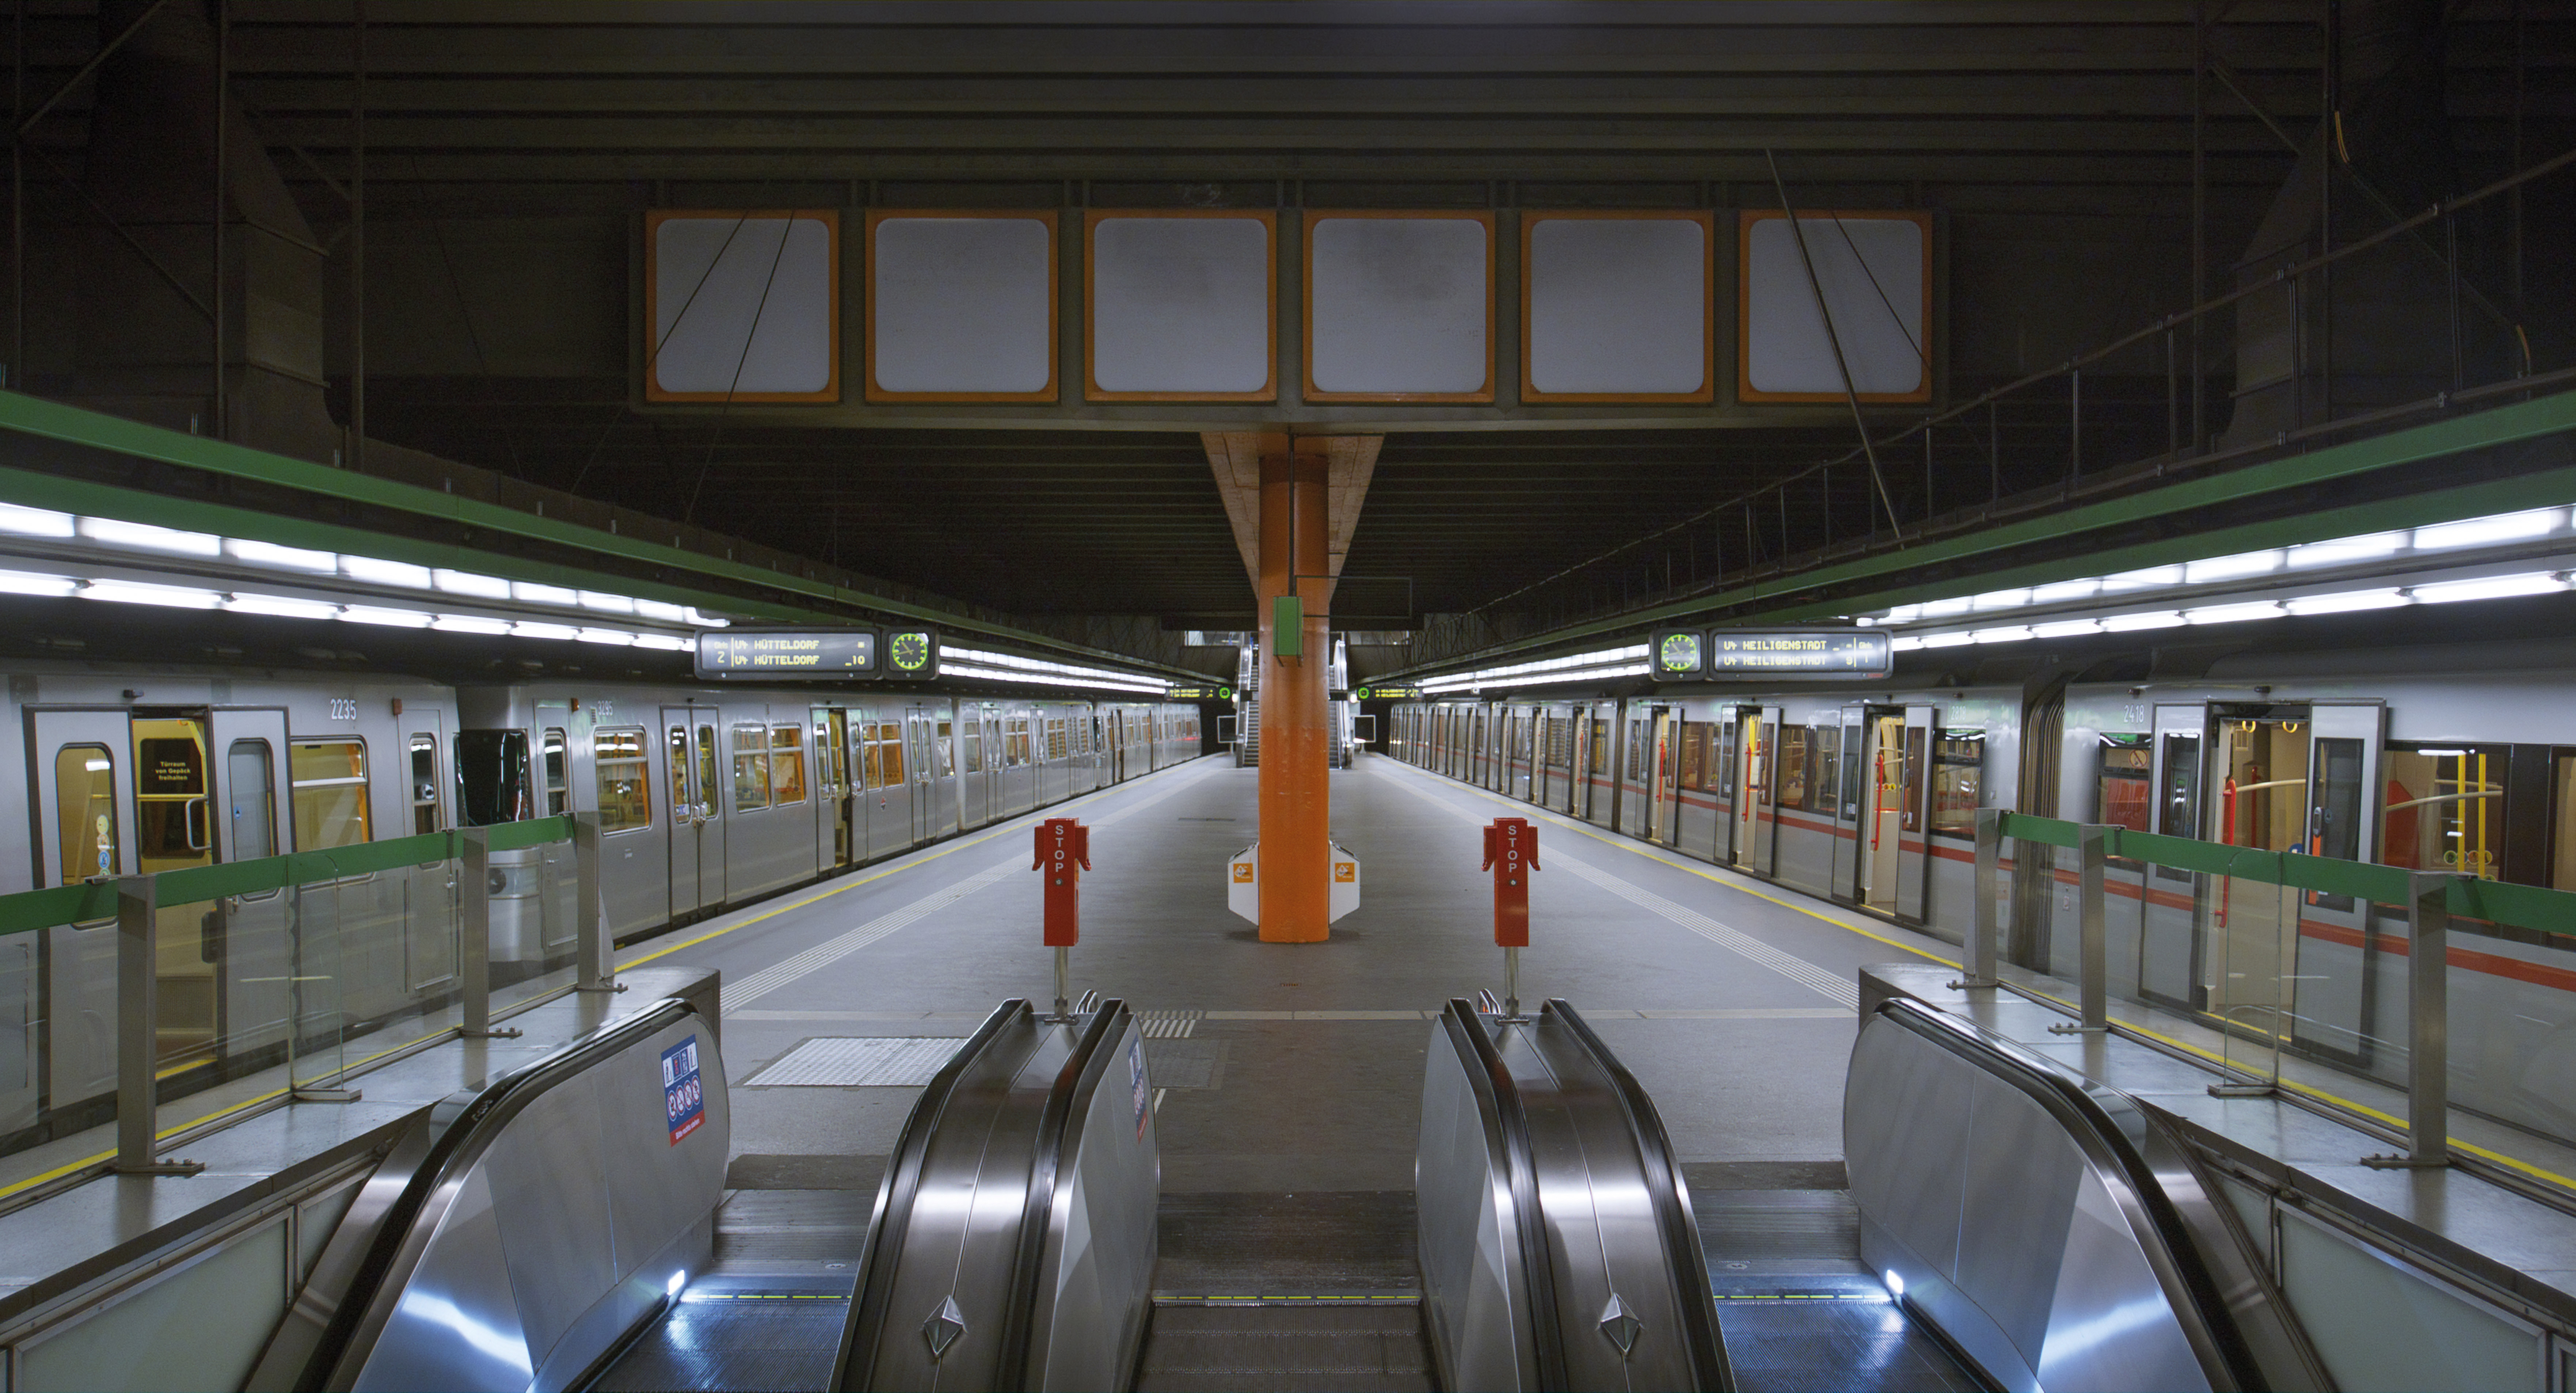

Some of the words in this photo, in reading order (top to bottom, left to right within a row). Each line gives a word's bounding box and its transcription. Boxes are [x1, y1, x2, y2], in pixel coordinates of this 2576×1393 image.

[735, 640, 748, 650] U4
[754, 639, 819, 650] HÜTTELDORF
[1723, 640, 1737, 650] U4
[1743, 640, 1827, 650] HEILIGENSTADT
[717, 651, 725, 663] 2
[735, 655, 748, 665] U4
[754, 654, 820, 665] HÜTTELDORF
[1723, 656, 1737, 666] U4
[1743, 656, 1827, 666] HEILIGENSTADT
[1846, 656, 1853, 665] 9
[330, 698, 357, 720] 2235
[2124, 704, 2145, 723] 2418
[1055, 825, 1065, 872] STOP
[1507, 825, 1518, 873] STOP
